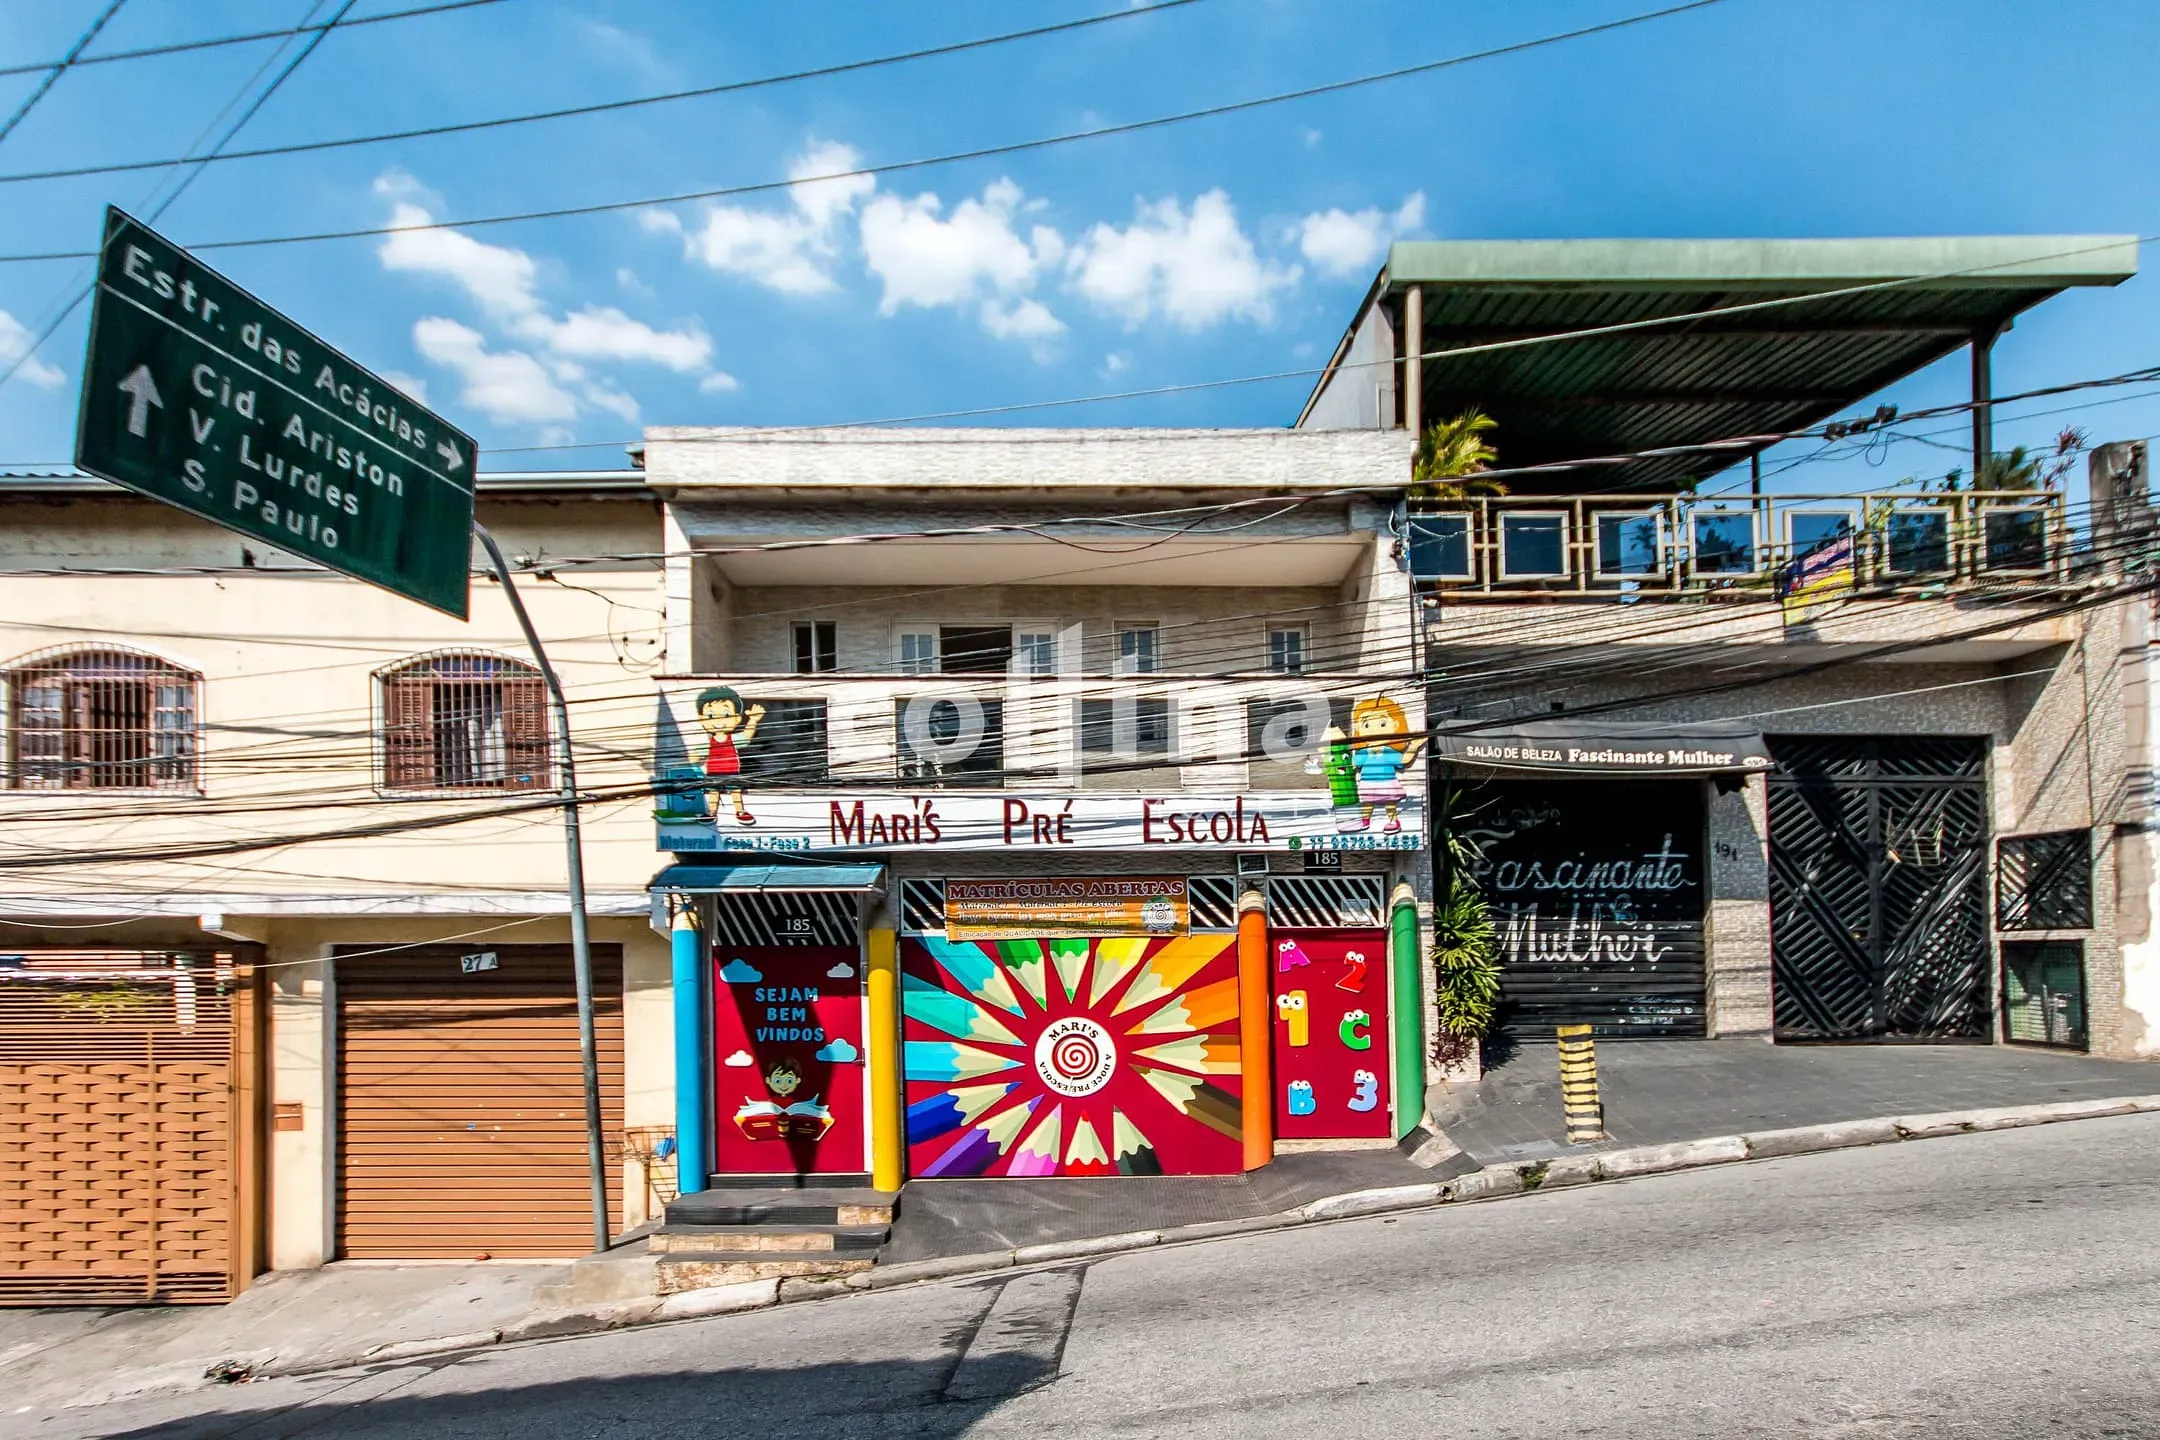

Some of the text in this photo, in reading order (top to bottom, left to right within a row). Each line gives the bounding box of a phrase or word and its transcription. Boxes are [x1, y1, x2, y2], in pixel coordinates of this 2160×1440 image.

[123, 243, 427, 450] Estr. das Acácias
[192, 363, 404, 497] Cid. Ariston
[190, 408, 359, 516] V. Lurdes
[182, 459, 339, 549] S. Paulo
[1466, 745, 1502, 759] SALÃO
[1504, 747, 1519, 759] DE
[1522, 749, 1563, 761] BELEZA
[1567, 749, 1665, 765] Fascinante
[1667, 750, 1734, 765] Mulher
[1313, 852, 1338, 865] 185
[949, 881, 1184, 899] MATRÍCULAS ABERTAS
[784, 918, 811, 932] 185
[463, 954, 482, 972] 27
[1279, 939, 1311, 973] A
[1335, 951, 1368, 993] 2
[755, 987, 819, 1003] SEJAM
[766, 1007, 807, 1022] BEM
[1277, 989, 1309, 1047] 1
[1339, 1009, 1371, 1050] C
[756, 1027, 825, 1042] VINDOS
[1048, 1021, 1099, 1041] MARI'S
[1039, 1061, 1072, 1092] ESCOLA
[1093, 1063, 1111, 1086] DOCE
[1288, 1080, 1316, 1115] B
[1347, 1069, 1378, 1112] 3
